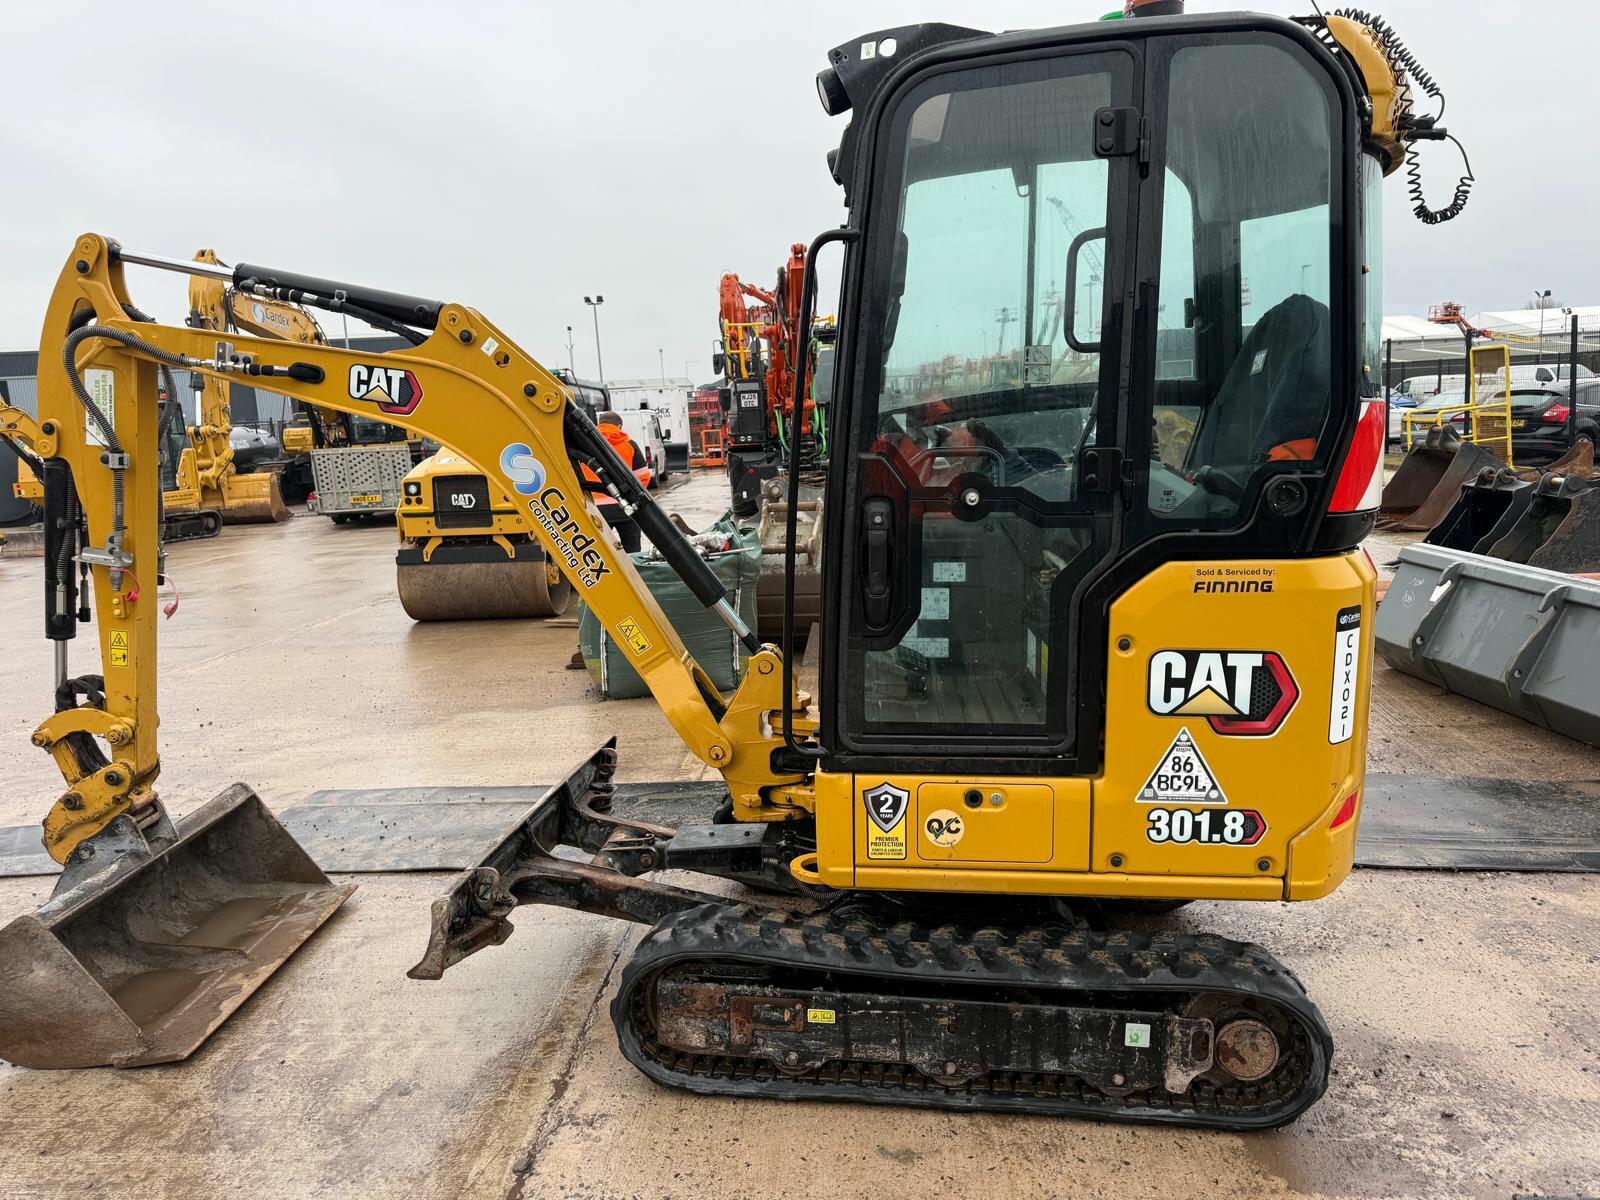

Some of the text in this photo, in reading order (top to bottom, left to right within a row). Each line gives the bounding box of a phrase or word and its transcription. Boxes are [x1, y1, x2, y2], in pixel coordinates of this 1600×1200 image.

[349, 364, 405, 404] CAT
[451, 494, 471, 506] CAT
[529, 499, 596, 587] Contracting Ltd
[540, 487, 611, 581] Cardex
[1225, 568, 1261, 576] Serviced
[1263, 568, 1276, 577] by:
[1193, 581, 1273, 593] FINNING
[1149, 651, 1263, 715] CAT
[1171, 756, 1194, 773] 86
[1157, 774, 1207, 792] BC9L
[879, 794, 894, 813] 2
[926, 818, 961, 835] QC
[1148, 809, 1245, 842] 301.8
